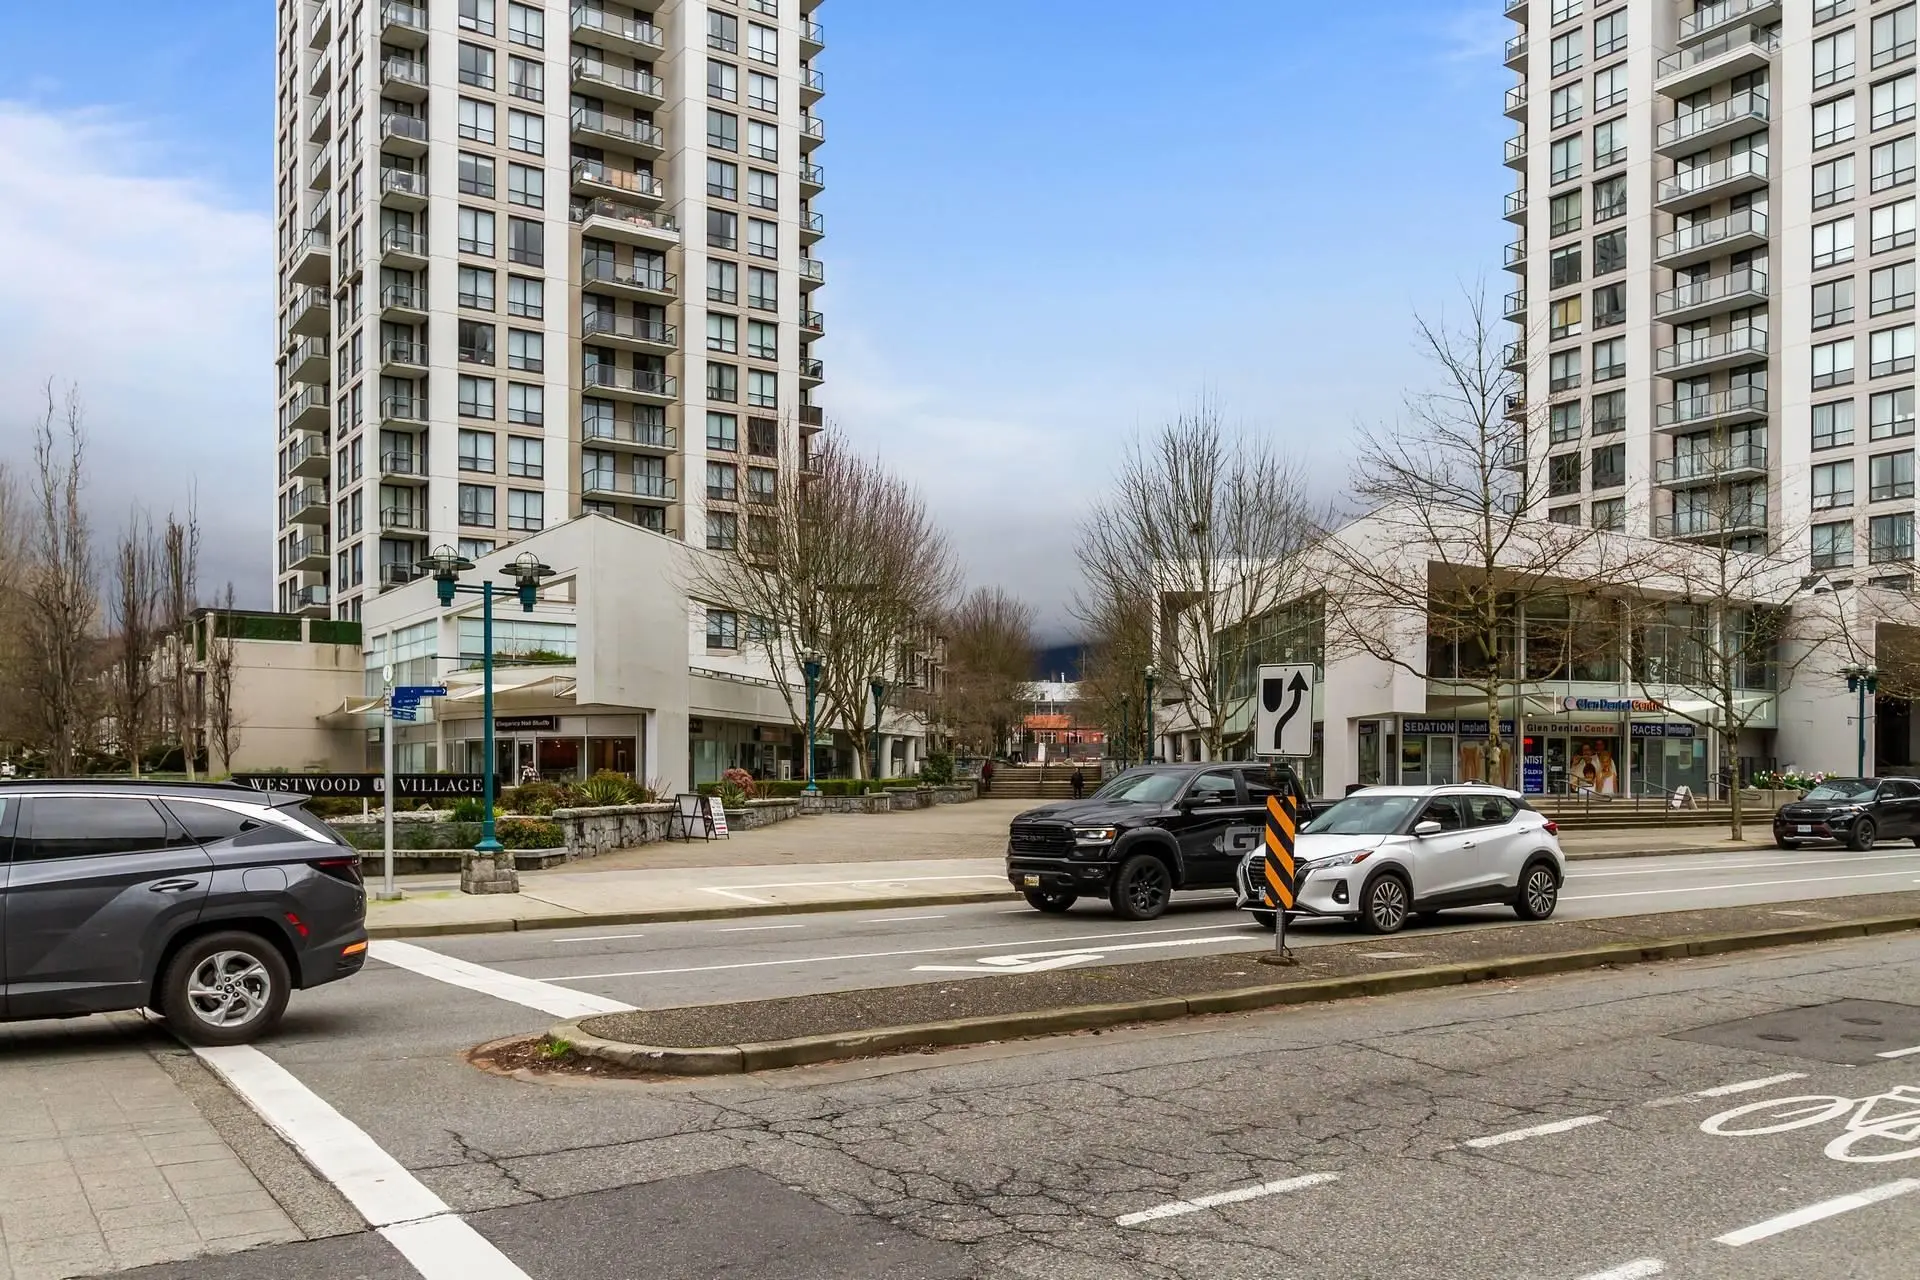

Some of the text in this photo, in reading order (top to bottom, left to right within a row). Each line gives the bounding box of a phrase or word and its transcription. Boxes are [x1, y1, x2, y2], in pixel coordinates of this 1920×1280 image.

[1576, 699, 1599, 711] Glen
[1600, 699, 1631, 712] Dental
[1404, 722, 1455, 732] SEDATION
[1461, 722, 1487, 733] Implant
[1526, 723, 1614, 733] Glen Dental Centre
[1631, 725, 1662, 735] RACES
[1524, 755, 1543, 765] NTIST
[250, 778, 484, 792] WESTWOOD VILLAGE
